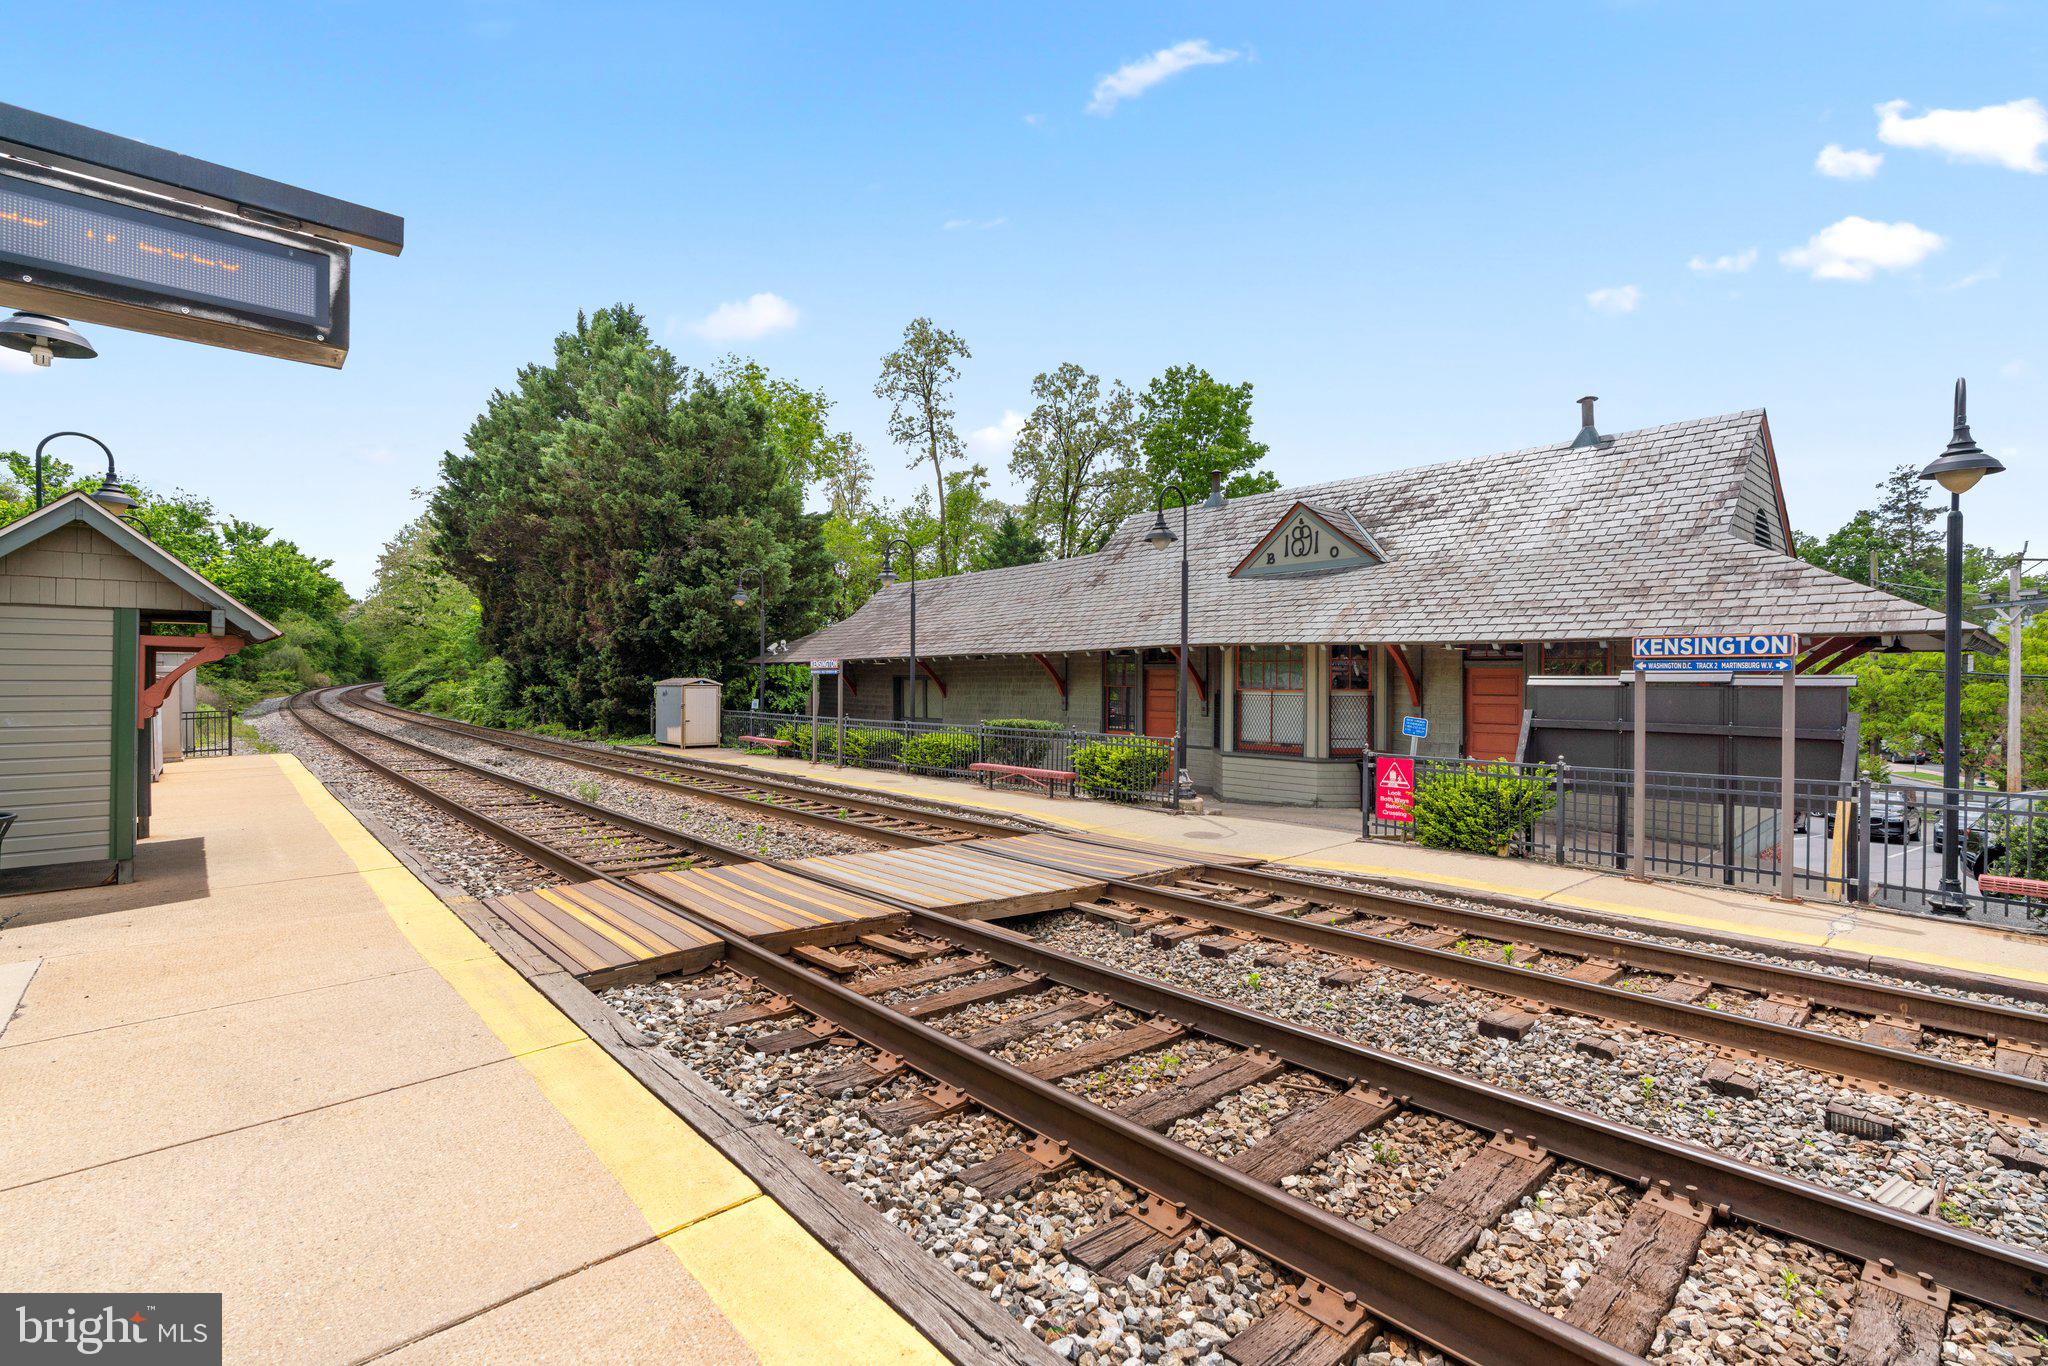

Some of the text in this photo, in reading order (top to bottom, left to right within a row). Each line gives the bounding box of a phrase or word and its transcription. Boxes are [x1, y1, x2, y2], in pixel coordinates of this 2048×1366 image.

[1284, 525, 1319, 557] 1891
[1266, 553, 1275, 564] B
[1330, 546, 1339, 558] O
[1635, 636, 1788, 655] KENSINGTON
[1382, 809, 1407, 818] Crossing
